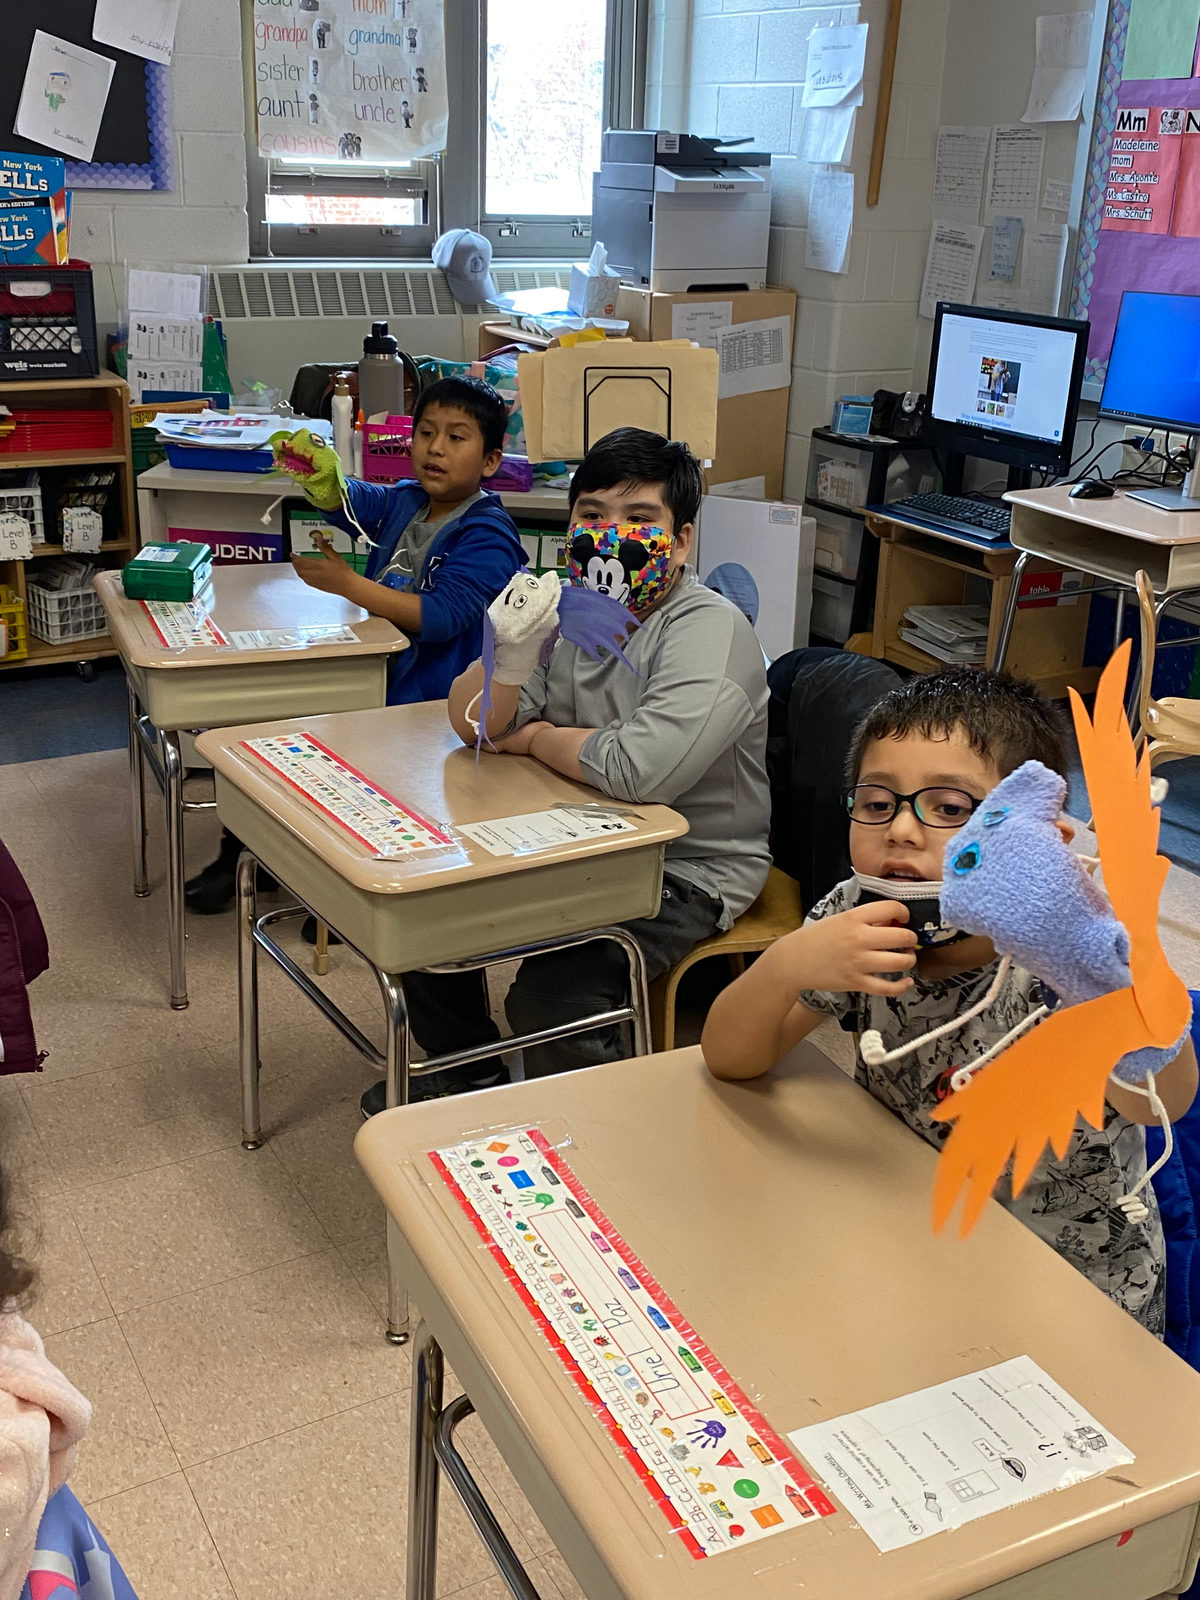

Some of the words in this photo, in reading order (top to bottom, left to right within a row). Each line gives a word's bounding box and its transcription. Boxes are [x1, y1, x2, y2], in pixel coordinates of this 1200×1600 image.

[255, 17, 308, 51] grandpa
[348, 25, 401, 56] grandma
[257, 54, 304, 82] sister
[352, 60, 408, 92] brother
[256, 90, 305, 118] aunt
[353, 98, 397, 123] uncle
[1116, 110, 1147, 131] Mm
[259, 132, 338, 155] cousins
[1113, 138, 1159, 151] Madeleine
[3, 160, 22, 169] New
[24, 162, 43, 172] York
[1111, 156, 1131, 166] mom
[10, 213, 28, 221] York
[0, 225, 34, 241] LLs
[2, 527, 25, 539] Level
[77, 519, 95, 531] Level
[82, 532, 90, 541] B
[10, 540, 18, 550] B
[176, 539, 277, 562] UDENT
[514, 1249, 527, 1261] Rr
[523, 1260, 538, 1276] Qq
[533, 1276, 548, 1290] Pp
[543, 1291, 557, 1305] Oo
[553, 1306, 567, 1320] Nn
[604, 1298, 633, 1329] Paz
[565, 1321, 581, 1340] Mm
[574, 1342, 590, 1353] Ll
[582, 1355, 601, 1369] Kk
[594, 1370, 612, 1384] Jj
[626, 1348, 678, 1393] Uriel
[610, 1395, 630, 1412] Hh
[628, 1412, 644, 1430] Gg
[635, 1432, 654, 1446] Ff
[652, 1449, 667, 1465] Ee
[660, 1468, 681, 1485] Dd
[678, 1487, 693, 1503] Cc
[843, 1477, 864, 1498] Writing
[686, 1505, 707, 1522] Bb
[705, 1525, 722, 1545] Aa
